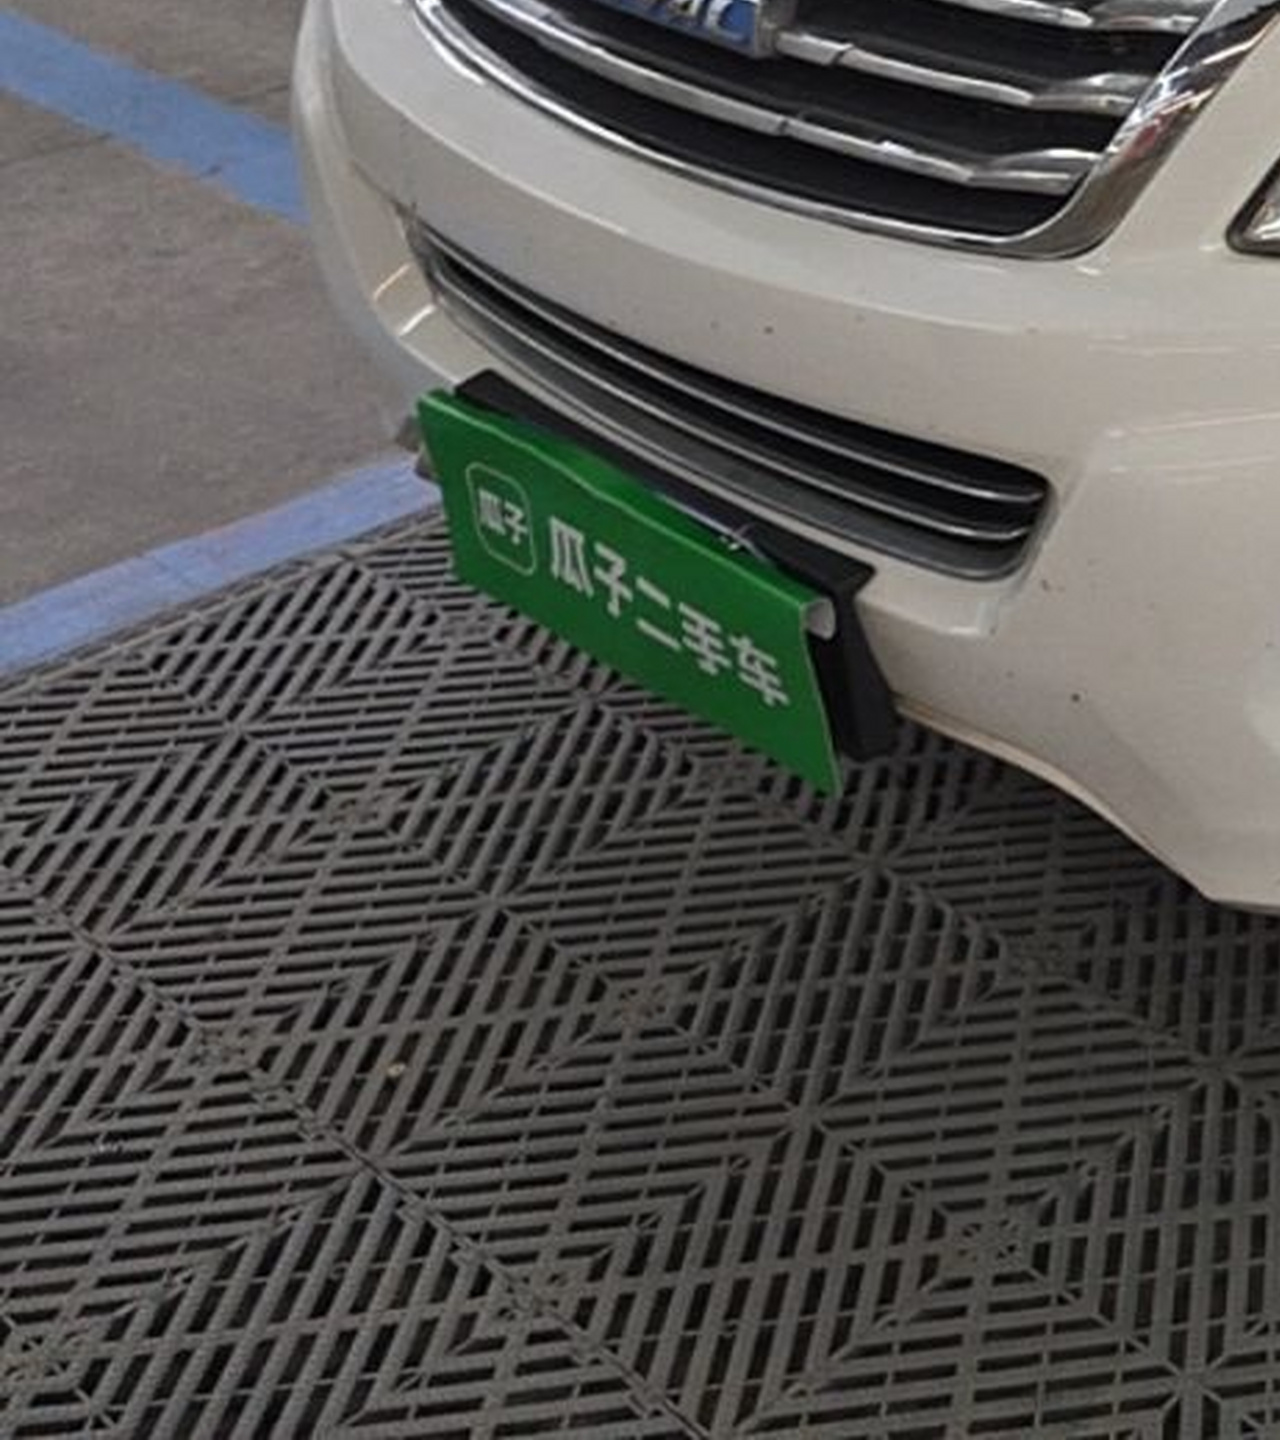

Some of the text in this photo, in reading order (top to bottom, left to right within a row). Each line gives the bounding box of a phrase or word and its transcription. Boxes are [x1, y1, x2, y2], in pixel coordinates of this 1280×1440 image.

[477, 487, 529, 546] 瓜子
[549, 515, 791, 708] 瓜子二手车
